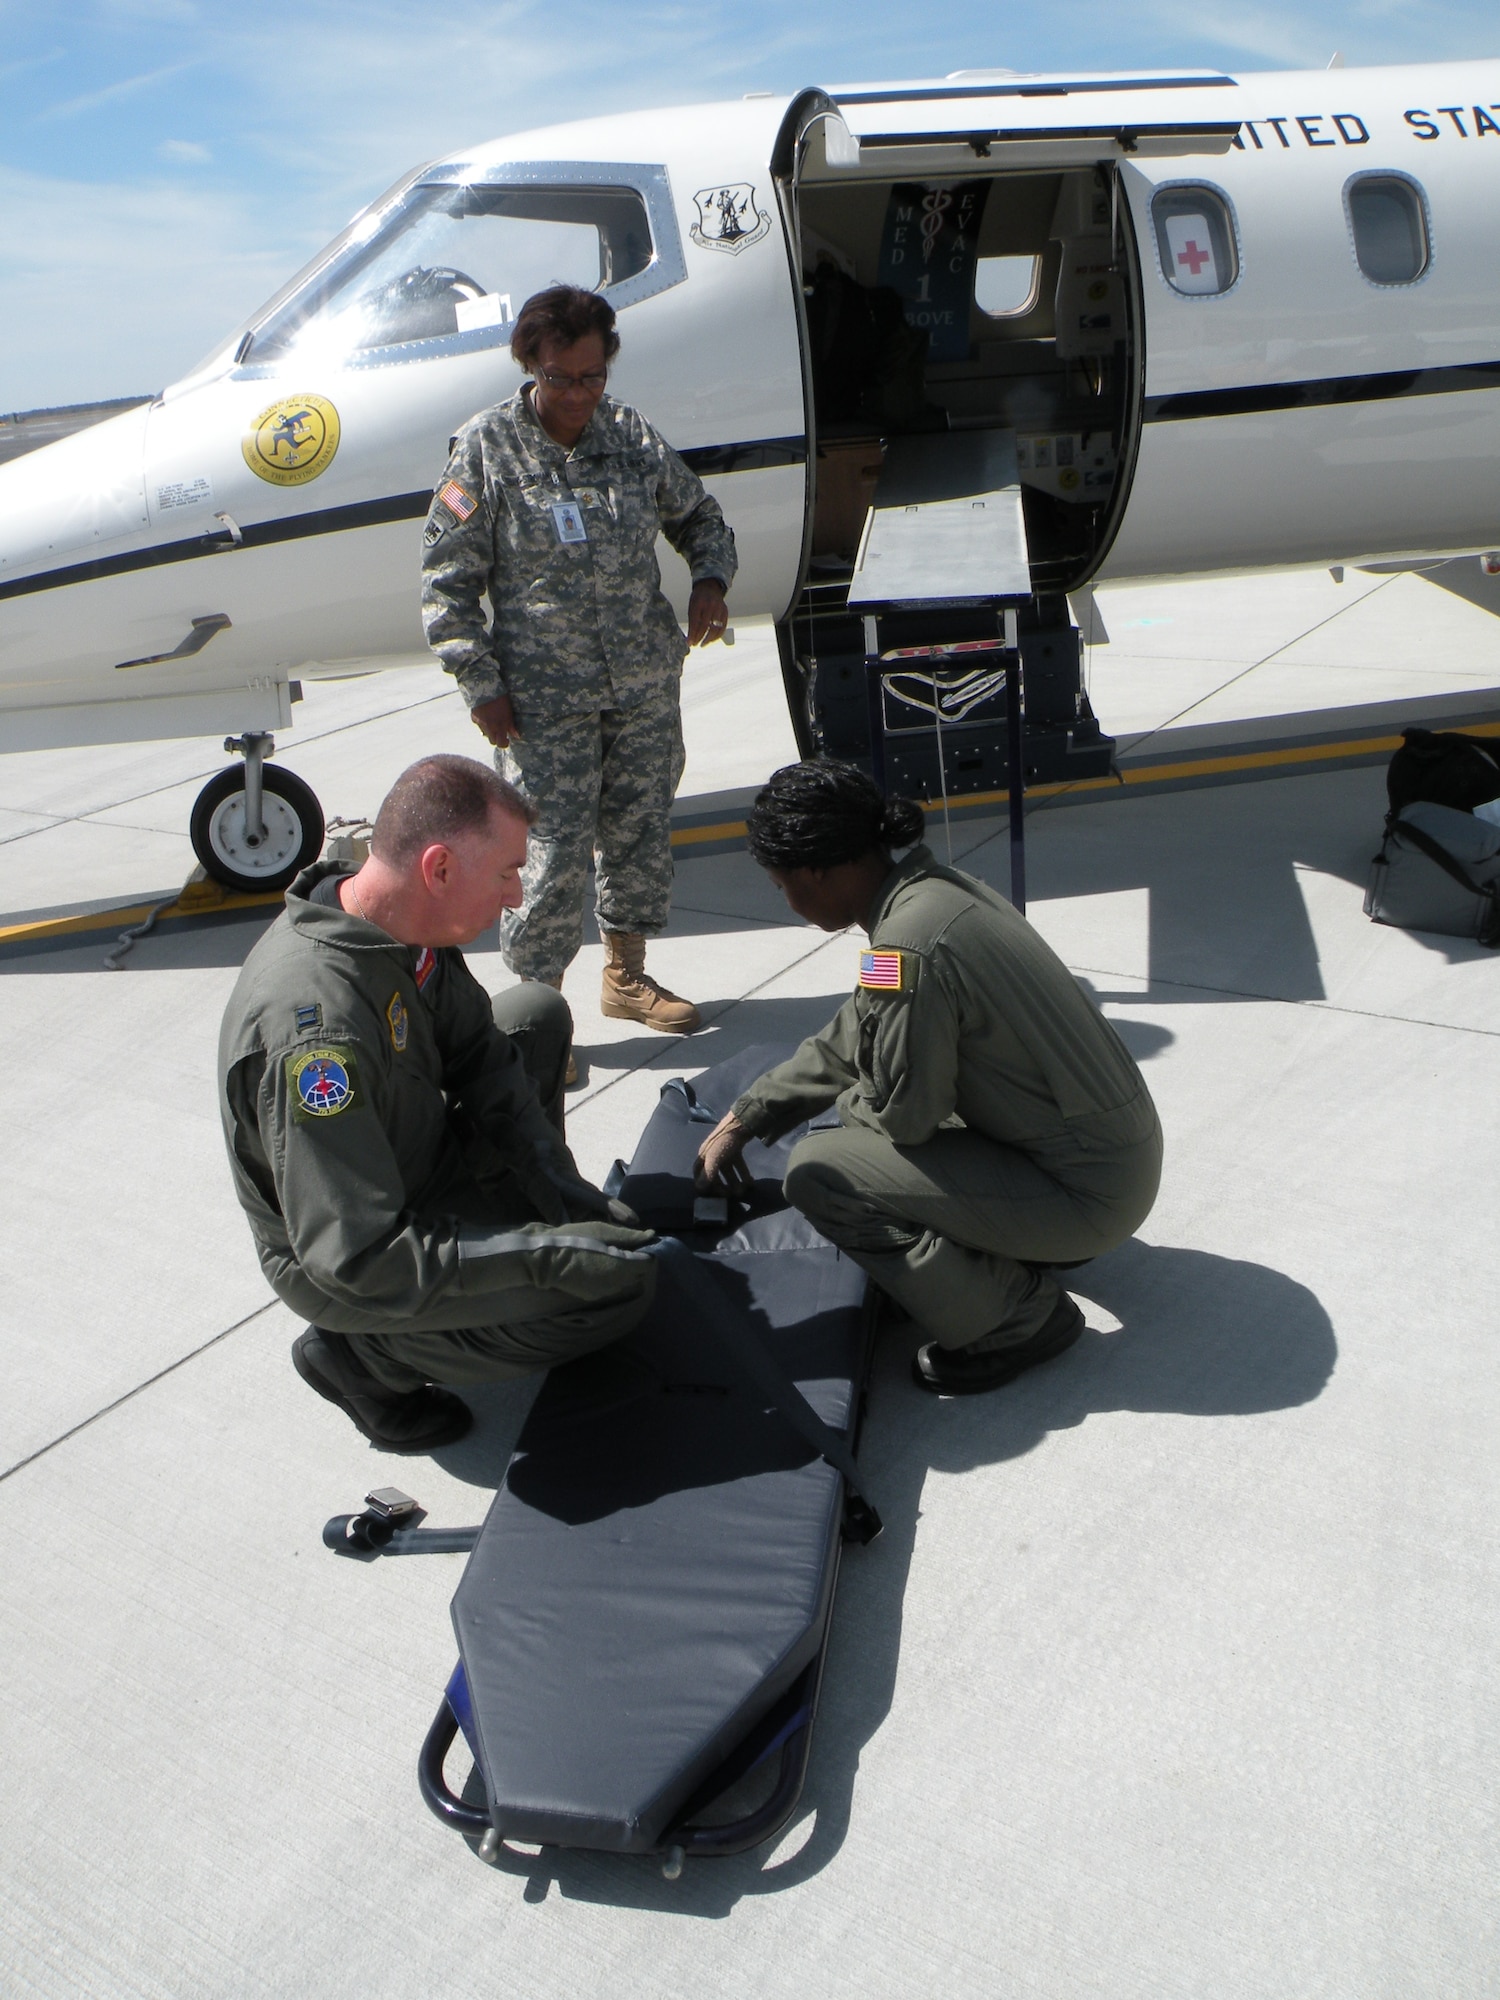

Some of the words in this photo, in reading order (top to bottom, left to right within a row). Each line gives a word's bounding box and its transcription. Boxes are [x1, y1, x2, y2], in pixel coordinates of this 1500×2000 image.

[1231, 114, 1370, 150] ITED
[701, 239, 713, 247] Air
[715, 240, 743, 252] National
[744, 228, 764, 244] Guard
[915, 273, 933, 303] 1
[905, 311, 954, 328] BOVE
[247, 445, 259, 467] HOME
[260, 465, 269, 475] OF
[270, 471, 286, 481] THE
[289, 466, 316, 481] FLYING
[315, 433, 336, 468] YANKEES
